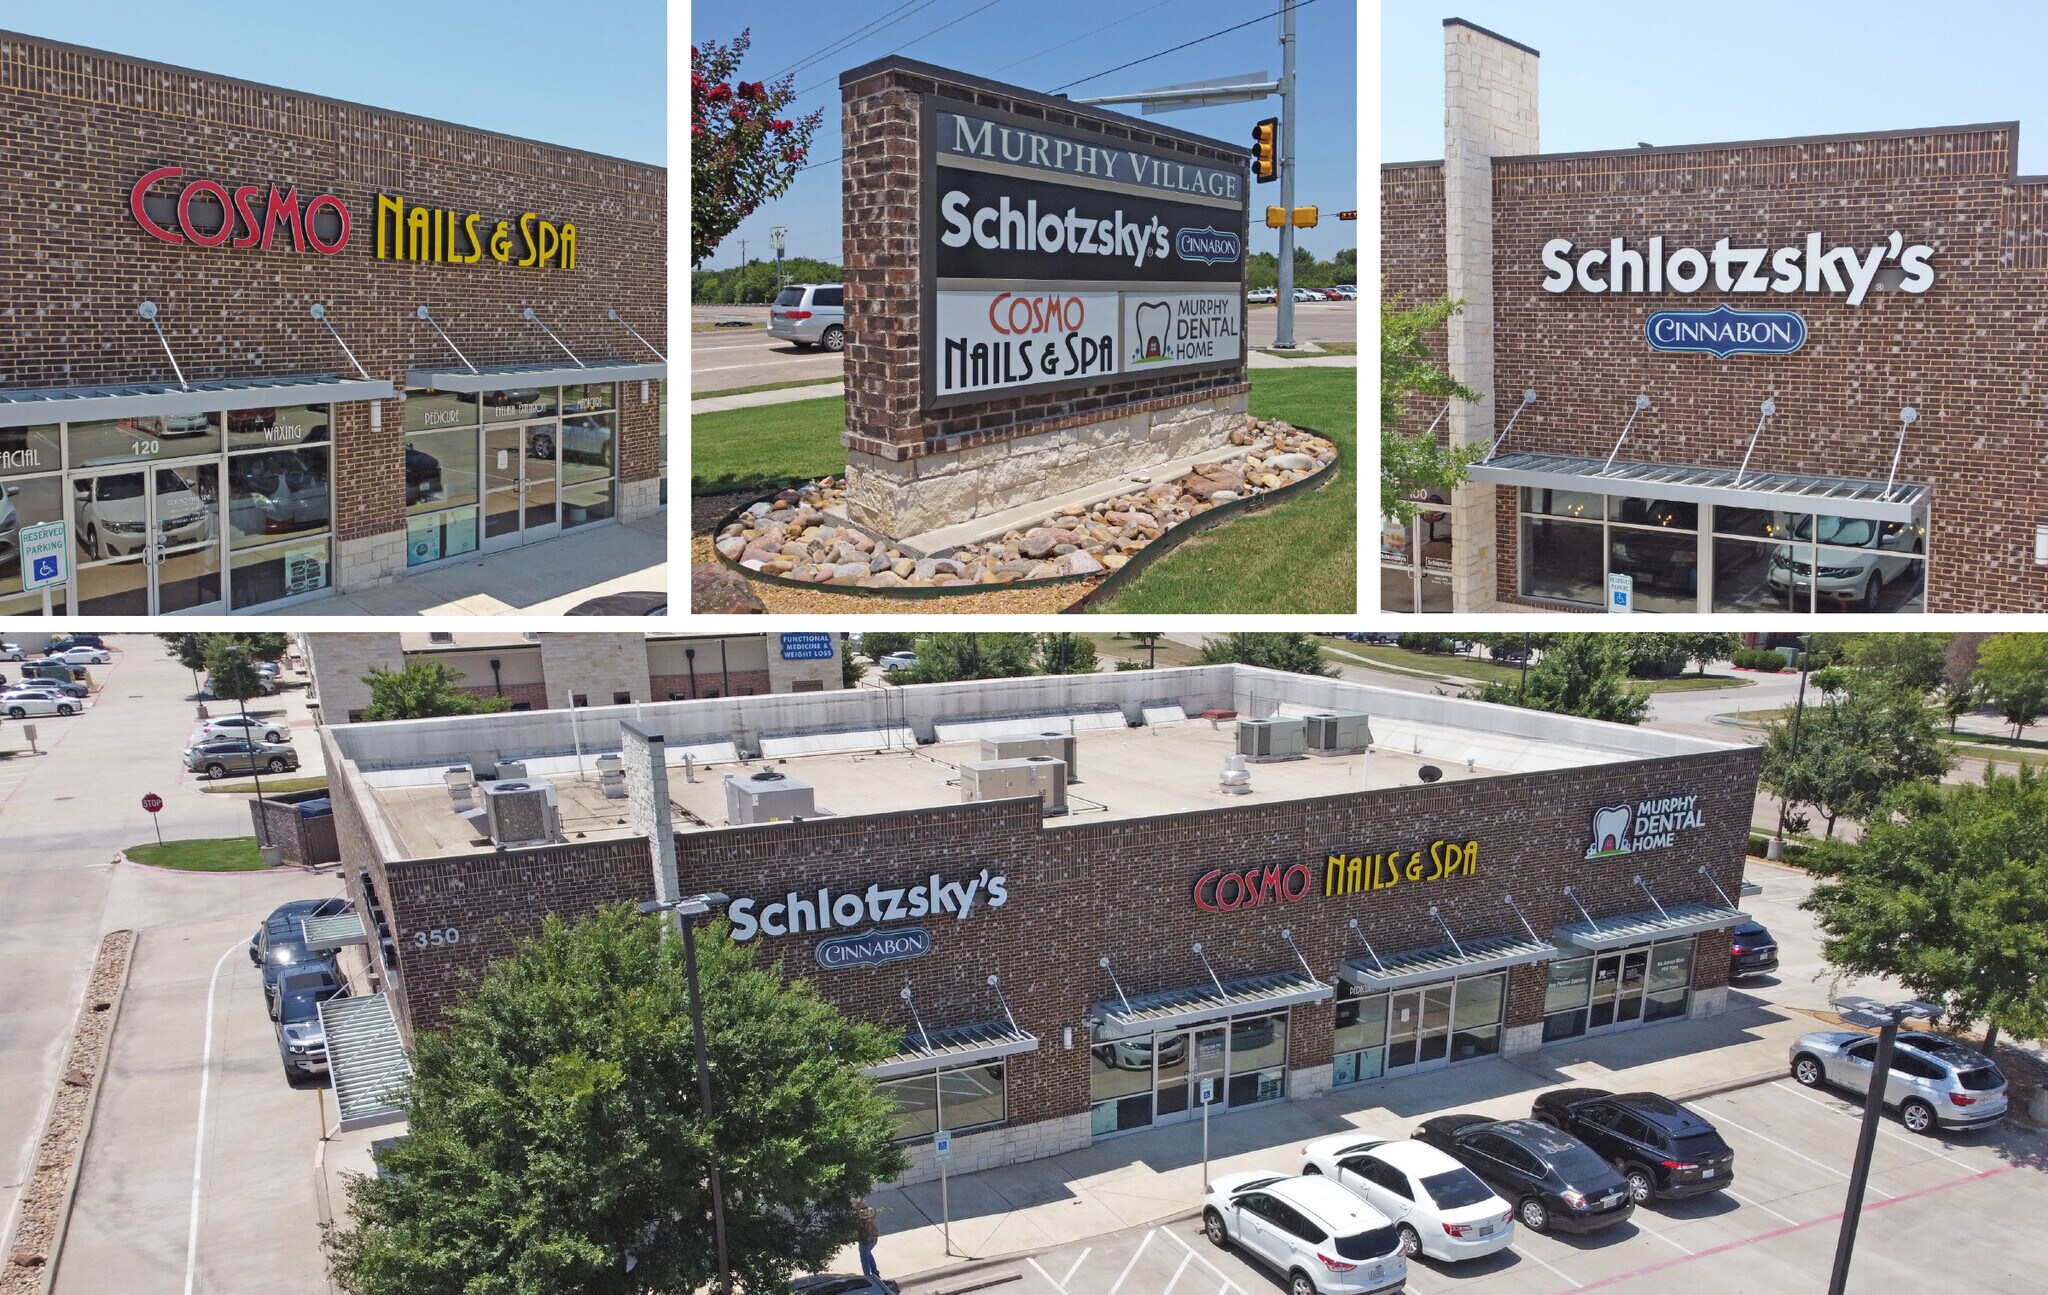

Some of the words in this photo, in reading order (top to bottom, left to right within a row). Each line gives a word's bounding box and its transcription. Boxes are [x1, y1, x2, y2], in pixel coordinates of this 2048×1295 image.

[952, 114, 1118, 178] MURPHY
[1127, 151, 1237, 199] VILLAGE
[131, 167, 350, 254] COSMO
[377, 193, 482, 264] NAILS
[490, 221, 513, 262] &
[518, 212, 576, 269] SPA
[941, 190, 1170, 268] Schlotzsky's
[1180, 235, 1236, 255] CINNABON
[1541, 229, 1936, 306] Schlotzsky's
[989, 292, 1085, 335] COSMO
[1177, 299, 1229, 317] MURPHY
[1176, 316, 1238, 341] DENTAL
[1654, 318, 1792, 344] CINNABON
[945, 337, 1033, 389] NAILS
[1040, 342, 1059, 375] &
[1064, 331, 1113, 376] SPA
[1176, 340, 1214, 360] HOME
[424, 409, 460, 425] PEDICURE
[263, 424, 302, 442] WAXING
[131, 440, 160, 455] 120
[23, 526, 64, 543] RESERVED
[26, 540, 63, 556] PARKING
[783, 635, 829, 643] FUNCTIONAL
[143, 799, 161, 808] STOP
[1637, 794, 1698, 816] MURPHY
[1634, 810, 1706, 836] DENTAL
[1632, 832, 1675, 852] HOME
[1194, 864, 1311, 912] COSMO
[1325, 852, 1399, 897] NAILS
[1405, 852, 1423, 881] &
[1427, 840, 1478, 881] SPA
[728, 868, 1008, 941] Schlotzsky's
[414, 927, 460, 948] 350
[825, 935, 923, 964] CINNABON
